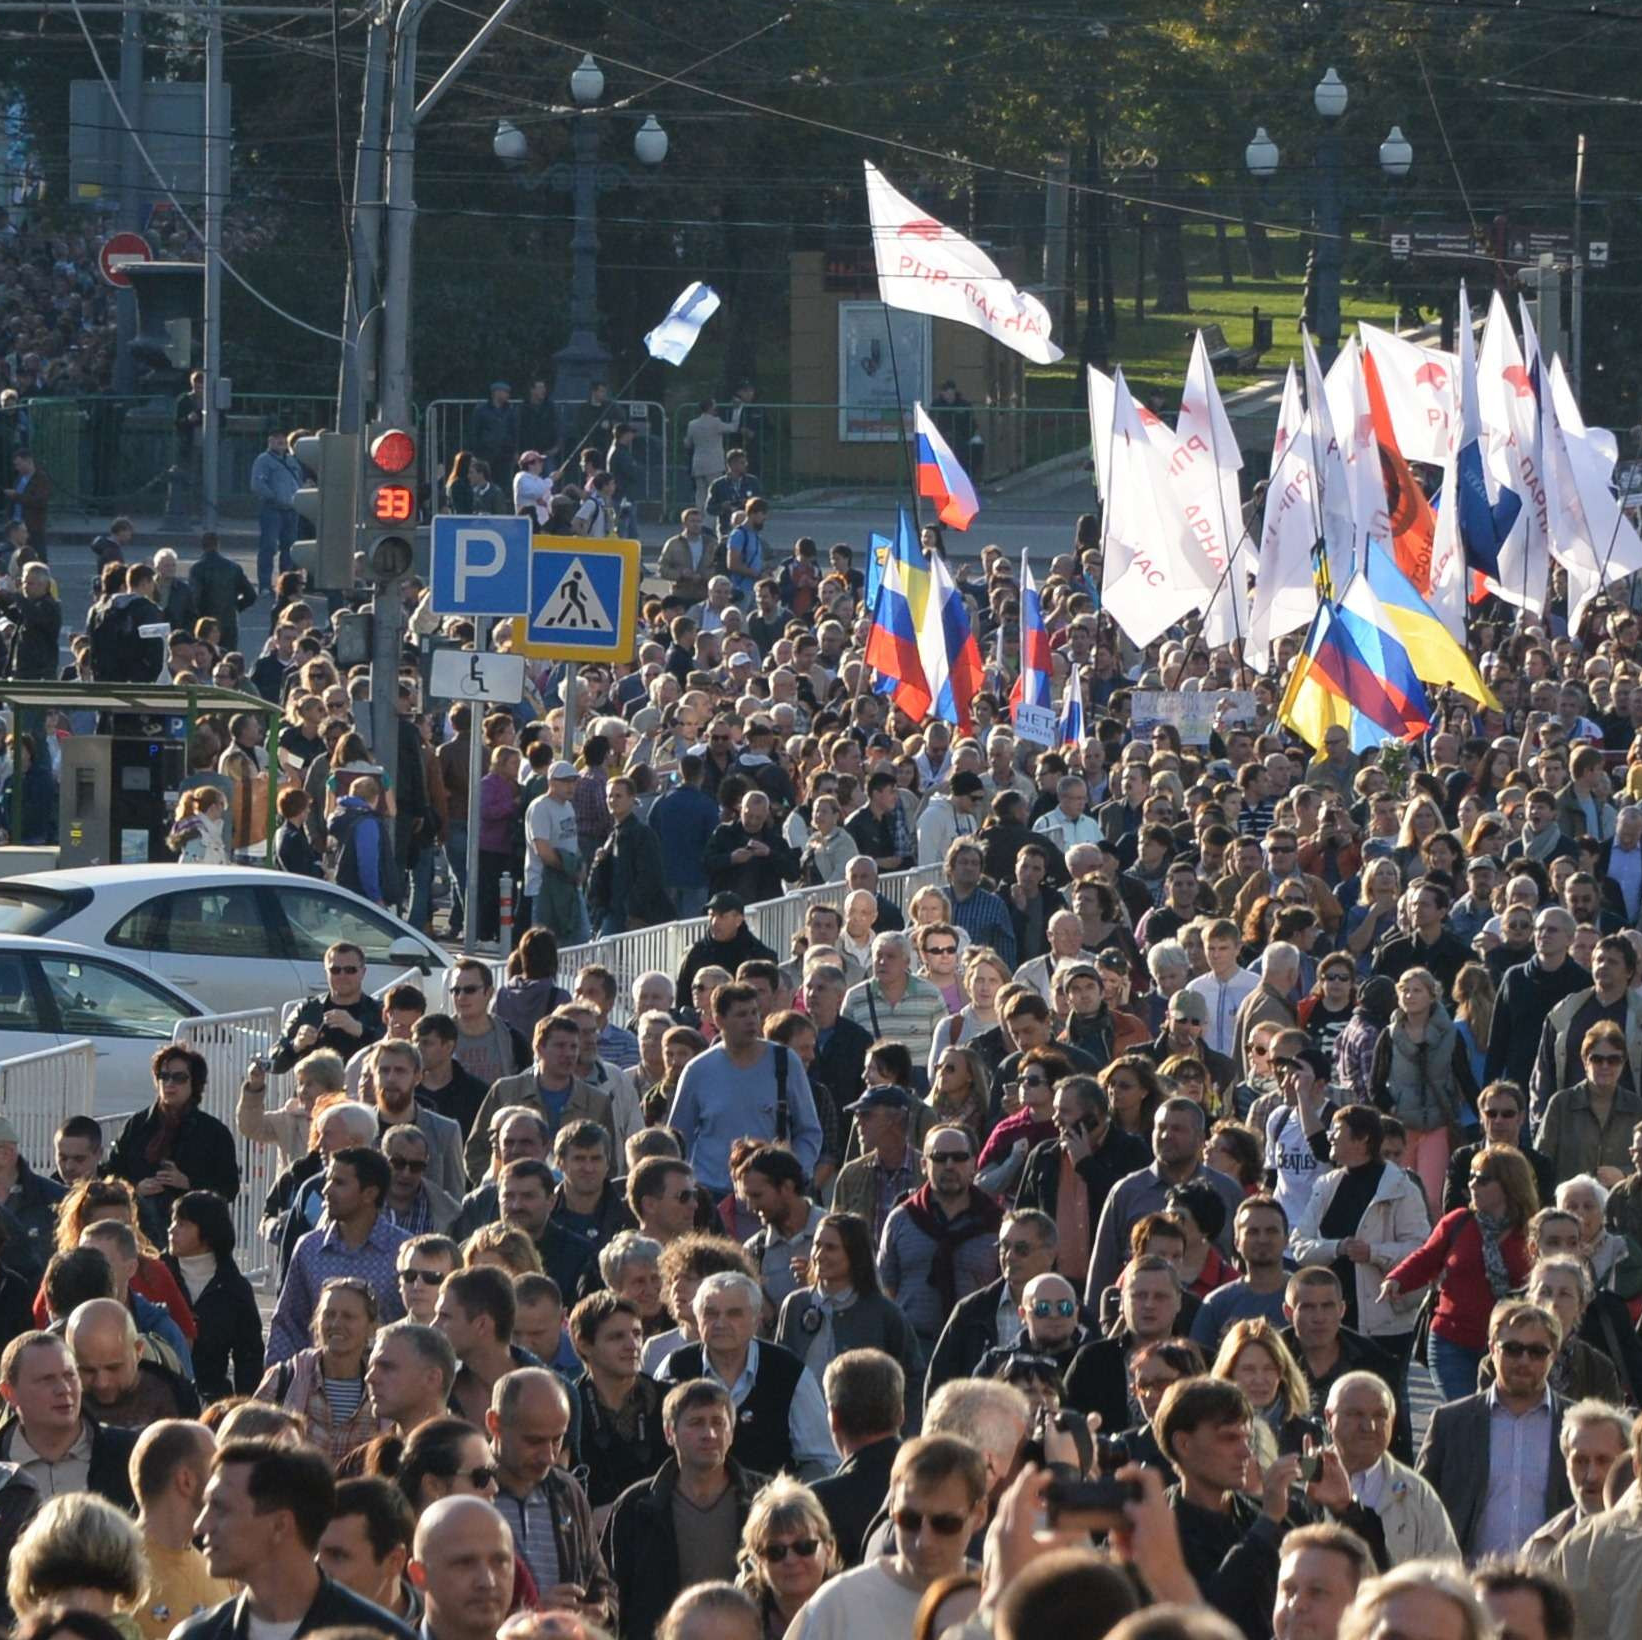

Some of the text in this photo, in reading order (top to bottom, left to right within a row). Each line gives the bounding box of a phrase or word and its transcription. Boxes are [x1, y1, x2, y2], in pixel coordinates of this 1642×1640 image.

[377, 488, 410, 519] 33
[454, 529, 506, 603] P
[1277, 1143, 1317, 1174] BEATLES
